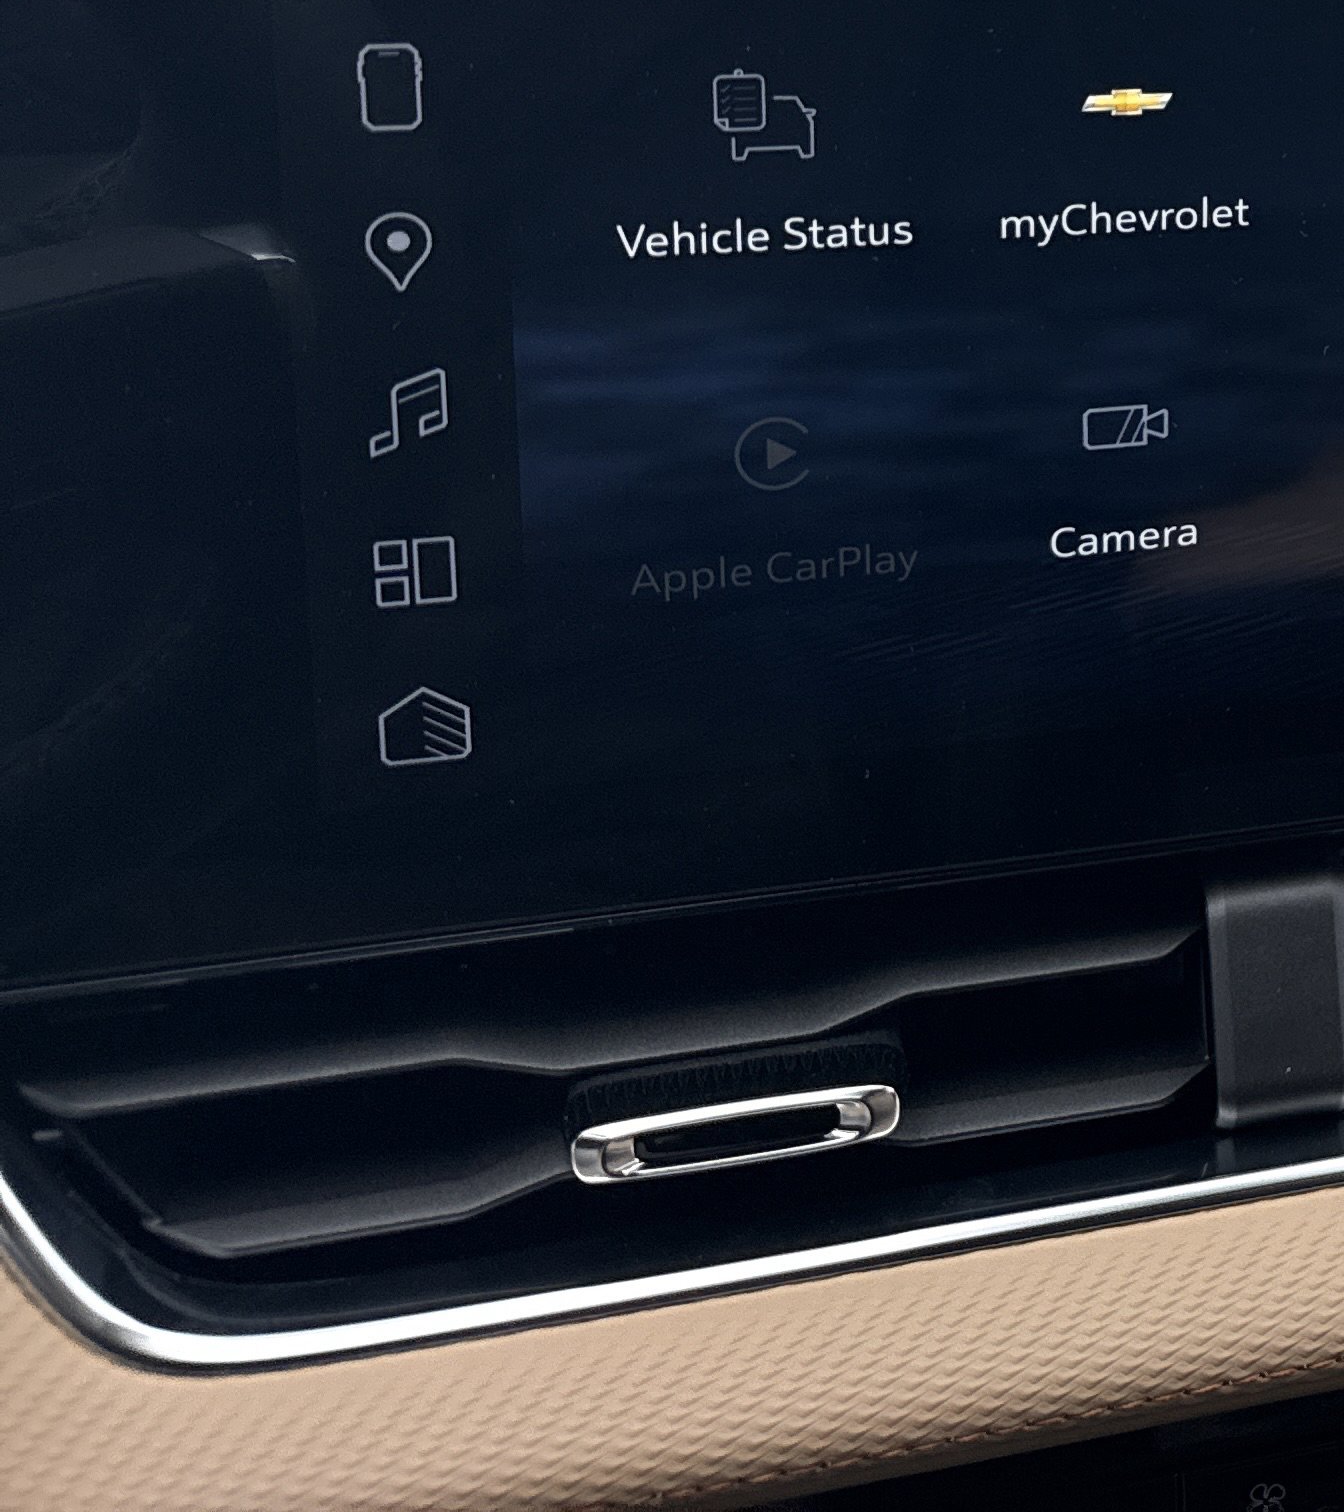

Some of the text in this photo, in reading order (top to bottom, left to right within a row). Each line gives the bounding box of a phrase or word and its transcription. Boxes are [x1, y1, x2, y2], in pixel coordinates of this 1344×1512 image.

[616, 216, 913, 258] Vehicle Status
[1000, 195, 1250, 247] myChevrolet
[1050, 524, 1198, 558] Camera
[630, 542, 920, 602] Apple CarPlay
